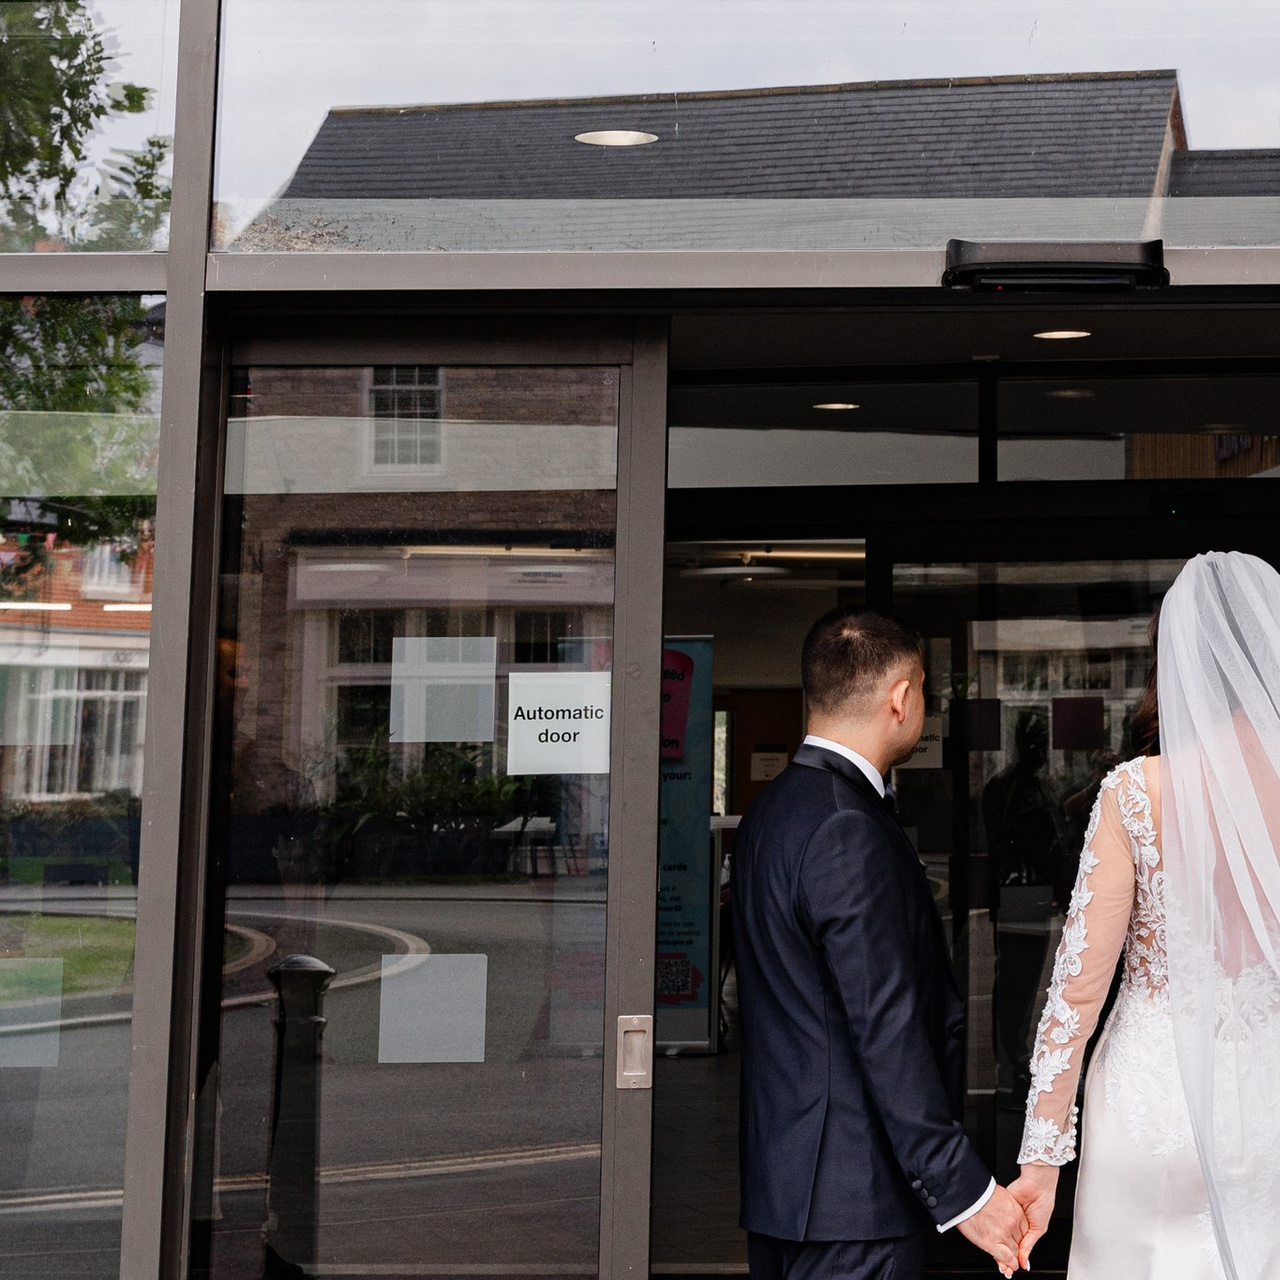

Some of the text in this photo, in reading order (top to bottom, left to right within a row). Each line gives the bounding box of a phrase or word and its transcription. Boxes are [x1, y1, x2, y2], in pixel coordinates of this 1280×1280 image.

[513, 704, 604, 721] Automatic
[537, 728, 580, 744] door
[662, 771, 692, 784] your:
